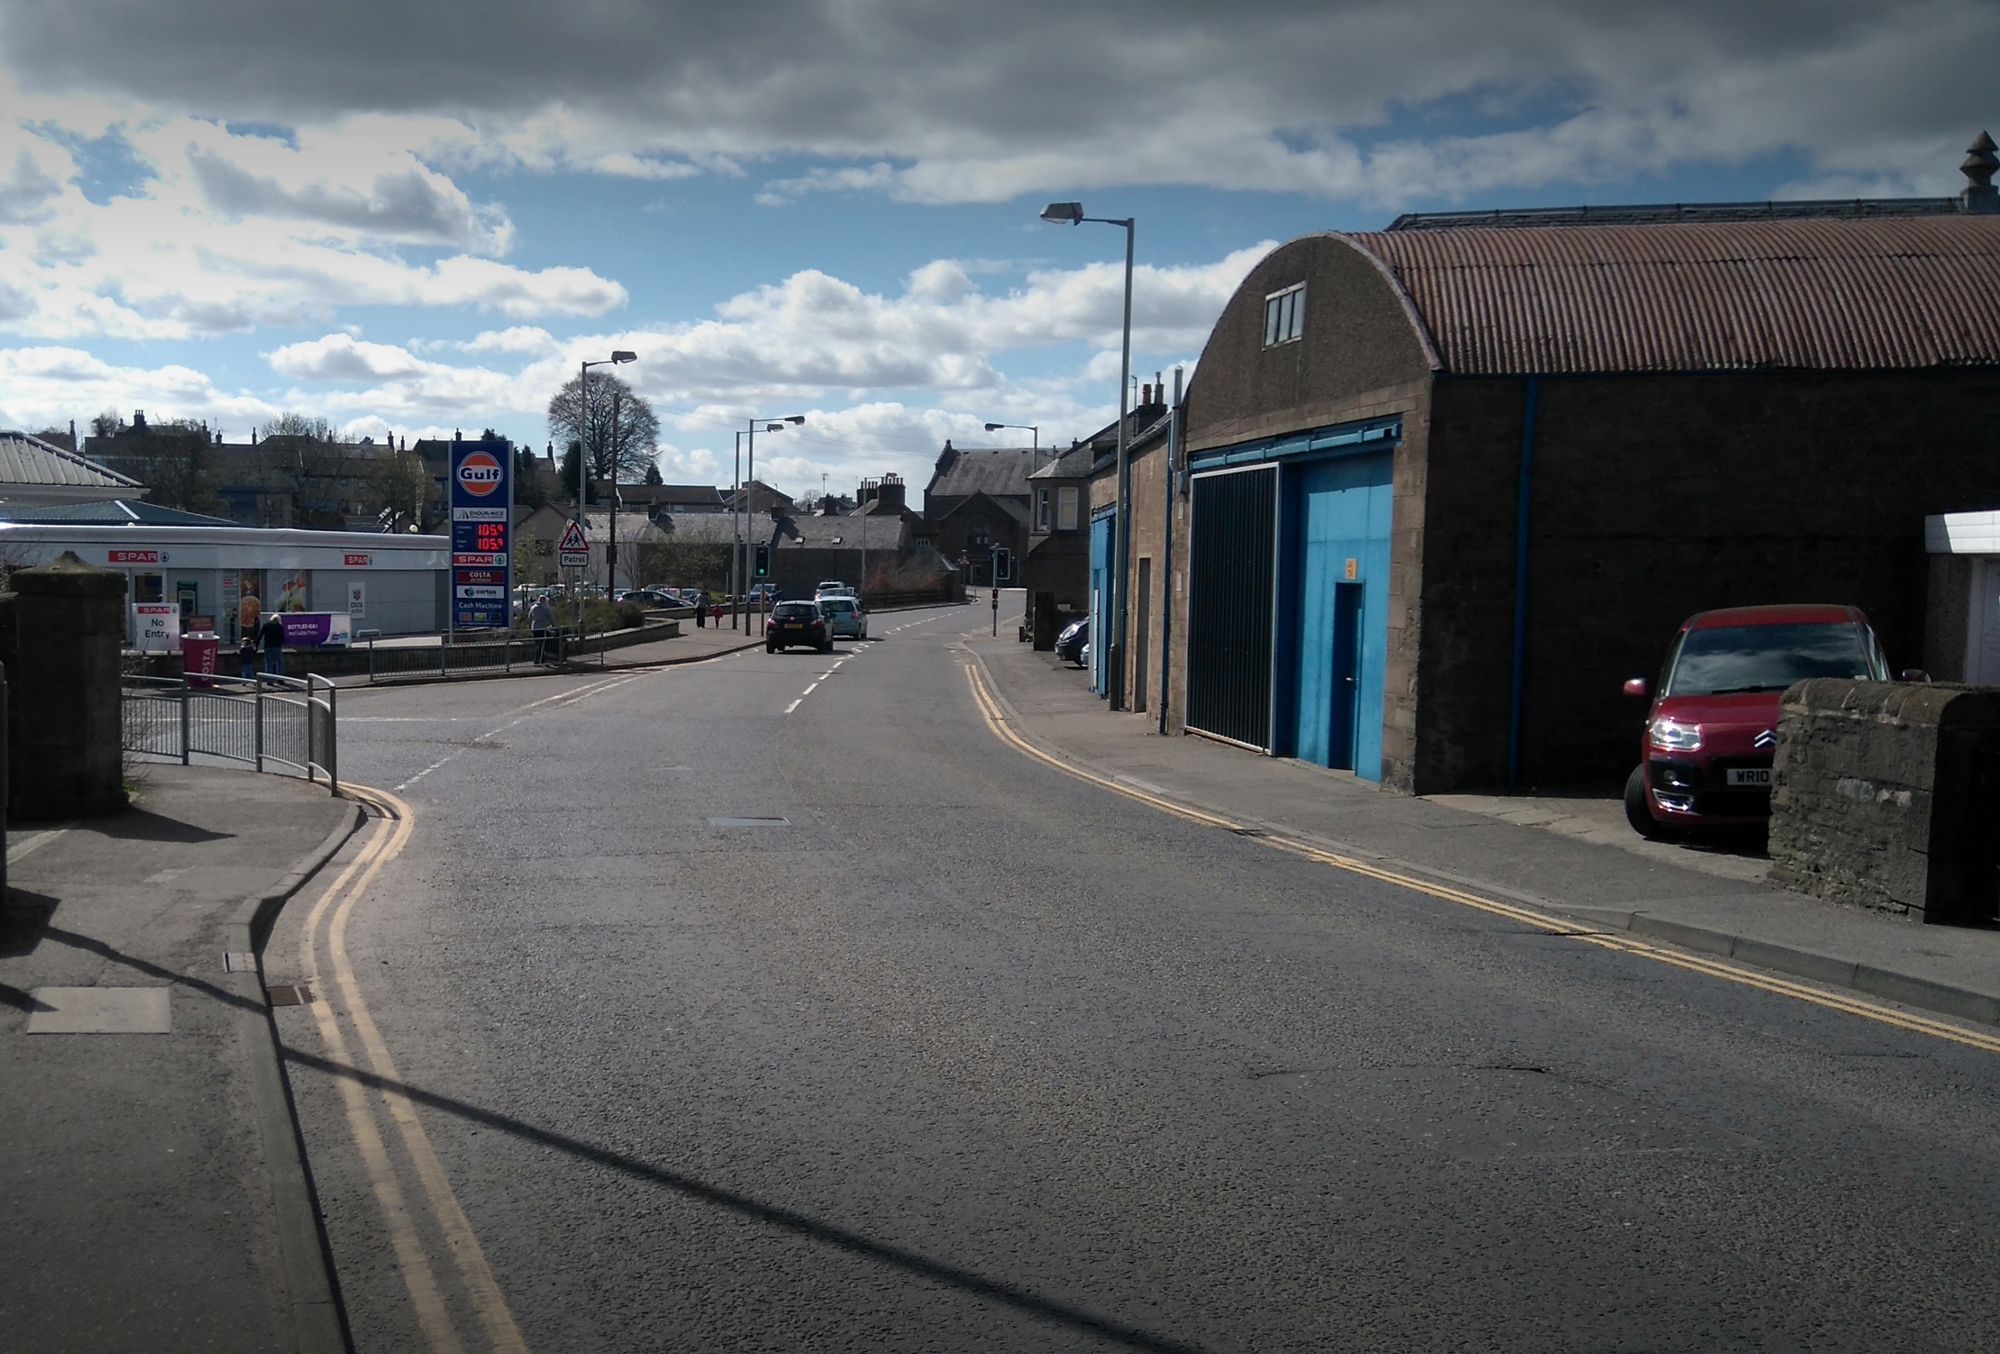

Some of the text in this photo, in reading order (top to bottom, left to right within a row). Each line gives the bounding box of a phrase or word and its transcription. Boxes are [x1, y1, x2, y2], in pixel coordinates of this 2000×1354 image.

[460, 467, 500, 480] Gulf
[117, 552, 157, 561] SPAR
[348, 556, 368, 564] SPAR
[564, 555, 586, 563] Patrol
[151, 618, 164, 627] No
[145, 629, 170, 639] Entry
